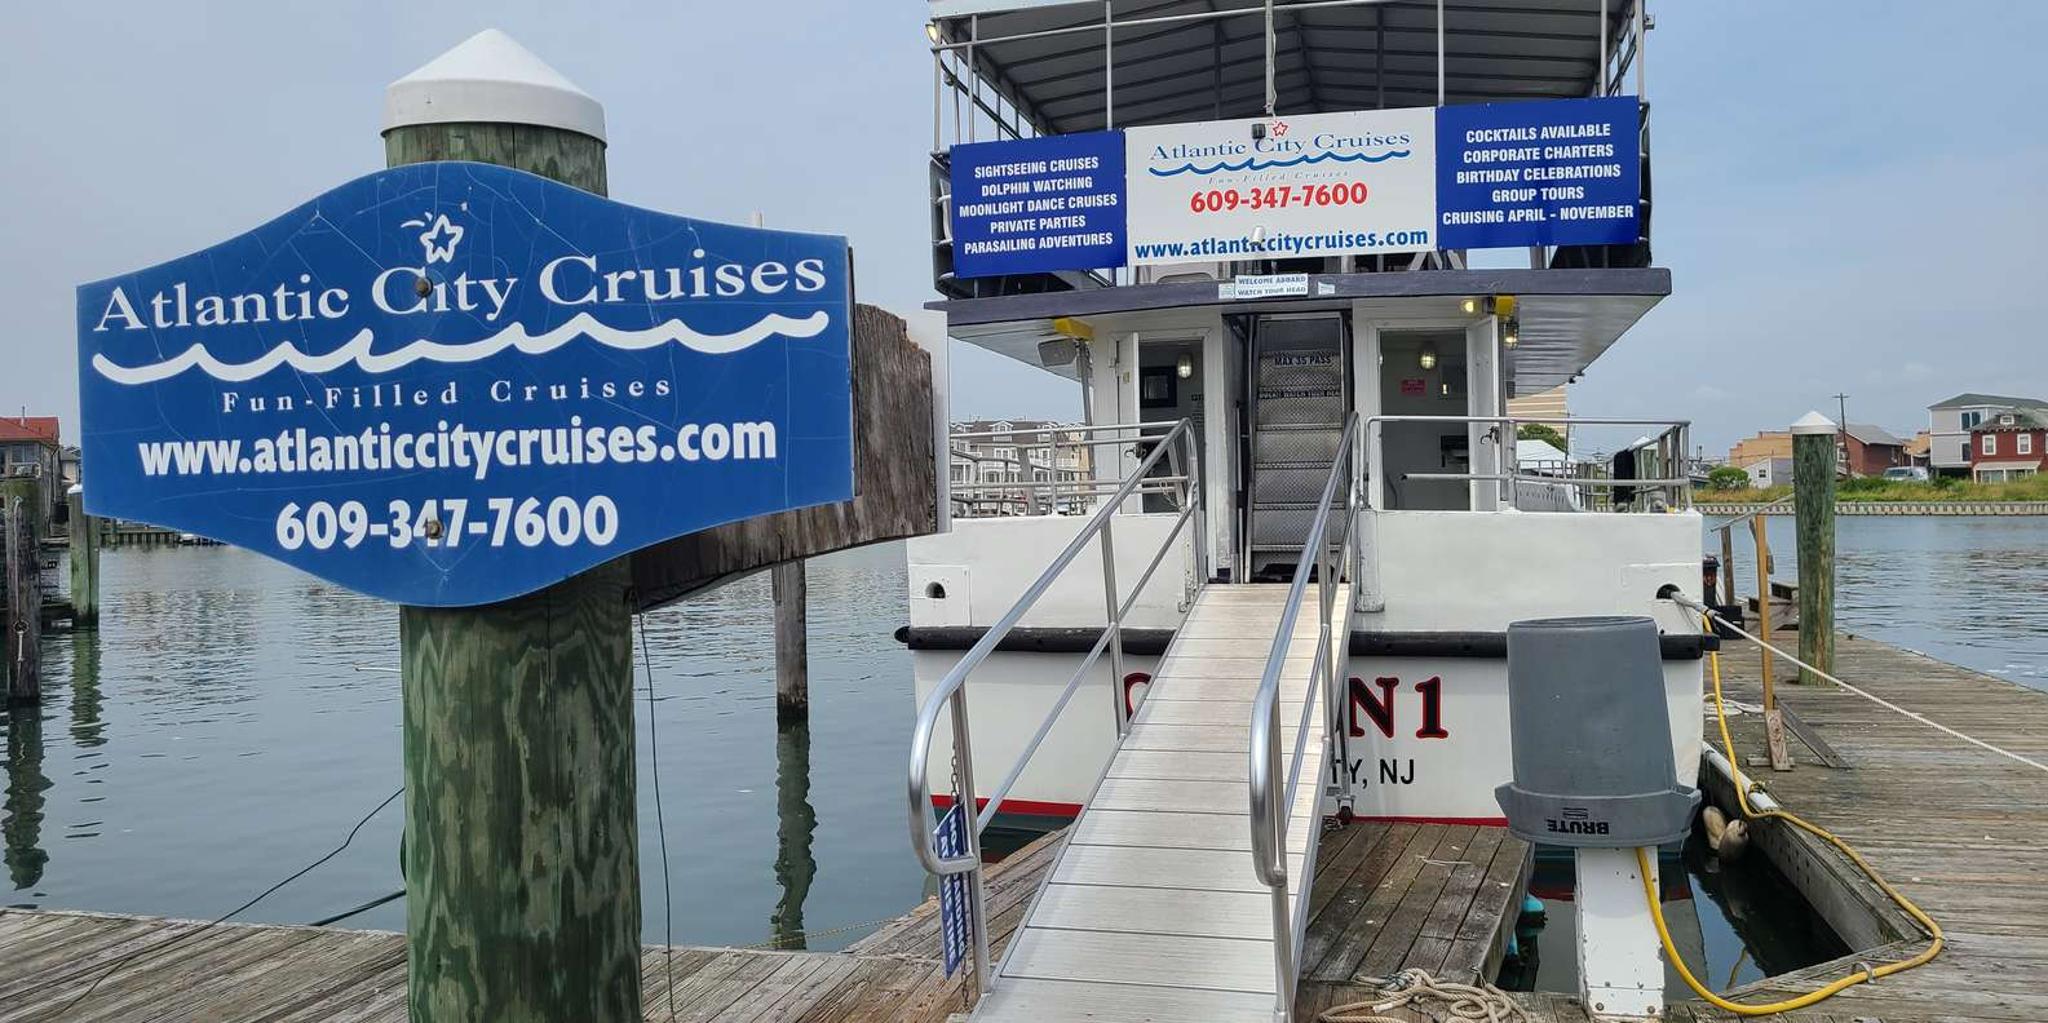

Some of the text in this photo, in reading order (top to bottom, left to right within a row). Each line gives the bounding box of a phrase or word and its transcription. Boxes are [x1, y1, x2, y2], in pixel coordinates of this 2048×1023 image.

[1466, 123, 1611, 143] COCKTAILS AVAILABLE
[1150, 131, 1410, 160] Atlantic City Cruises
[1463, 144, 1614, 163] CORPORATE CHARTERS
[974, 156, 1099, 179] SIGHTSEEING CRUISES
[1457, 164, 1621, 184] BIRTHDAY CELEBRATIONS
[981, 176, 1093, 197] DOLPHIN WATCHING
[1492, 186, 1584, 203] GROUP TOURS
[959, 193, 1118, 218] MOONLIGHT DANCE CRUISES
[1190, 182, 1368, 214] 609-347-7600
[990, 215, 1086, 233] PRIVATE PARTIES
[1442, 210, 1505, 225] CRUISING
[1507, 208, 1547, 223] APRIL
[1560, 205, 1634, 221] NOVEMBER
[964, 232, 1114, 255] PARASAILING ADVENTURES
[93, 248, 827, 333] Atlantic City Cruises
[1237, 288, 1264, 296] WATCH
[1238, 277, 1274, 285] WELCOME
[221, 376, 671, 414] Fun-Filled Cruises
[138, 415, 777, 481] www.atlanticcitycruises.com
[275, 495, 619, 550] 609-347-7600
[1378, 757, 1415, 785] NJ
[1547, 818, 1609, 835] BRUTE
